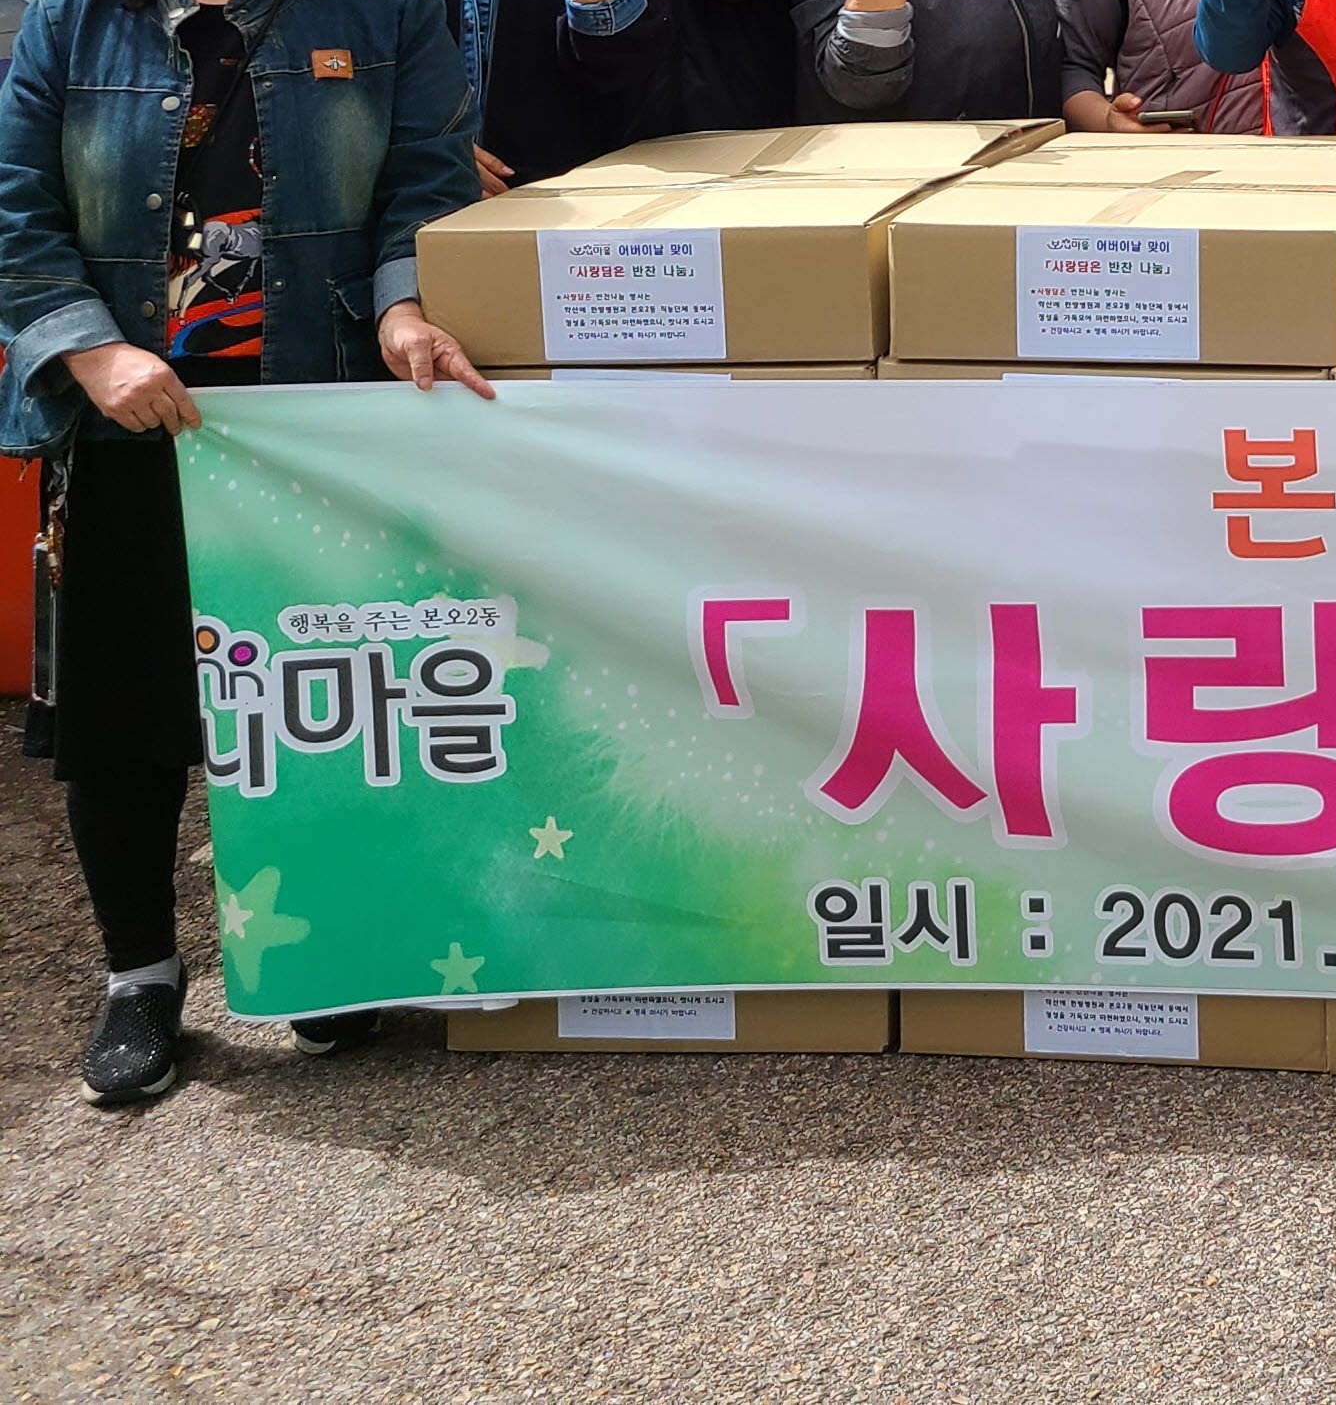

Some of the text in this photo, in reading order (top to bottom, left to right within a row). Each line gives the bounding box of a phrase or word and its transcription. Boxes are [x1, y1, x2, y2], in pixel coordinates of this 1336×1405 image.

[619, 243, 664, 257] 어버이날
[1097, 240, 1141, 252] 어버이날
[1148, 241, 1170, 253] 맞이
[632, 266, 656, 278] 반찬
[1109, 262, 1132, 274] 반찬
[1140, 263, 1170, 274] 나눔」
[289, 606, 501, 635] 행복을 주는 본오2동
[814, 884, 970, 959] 일시
